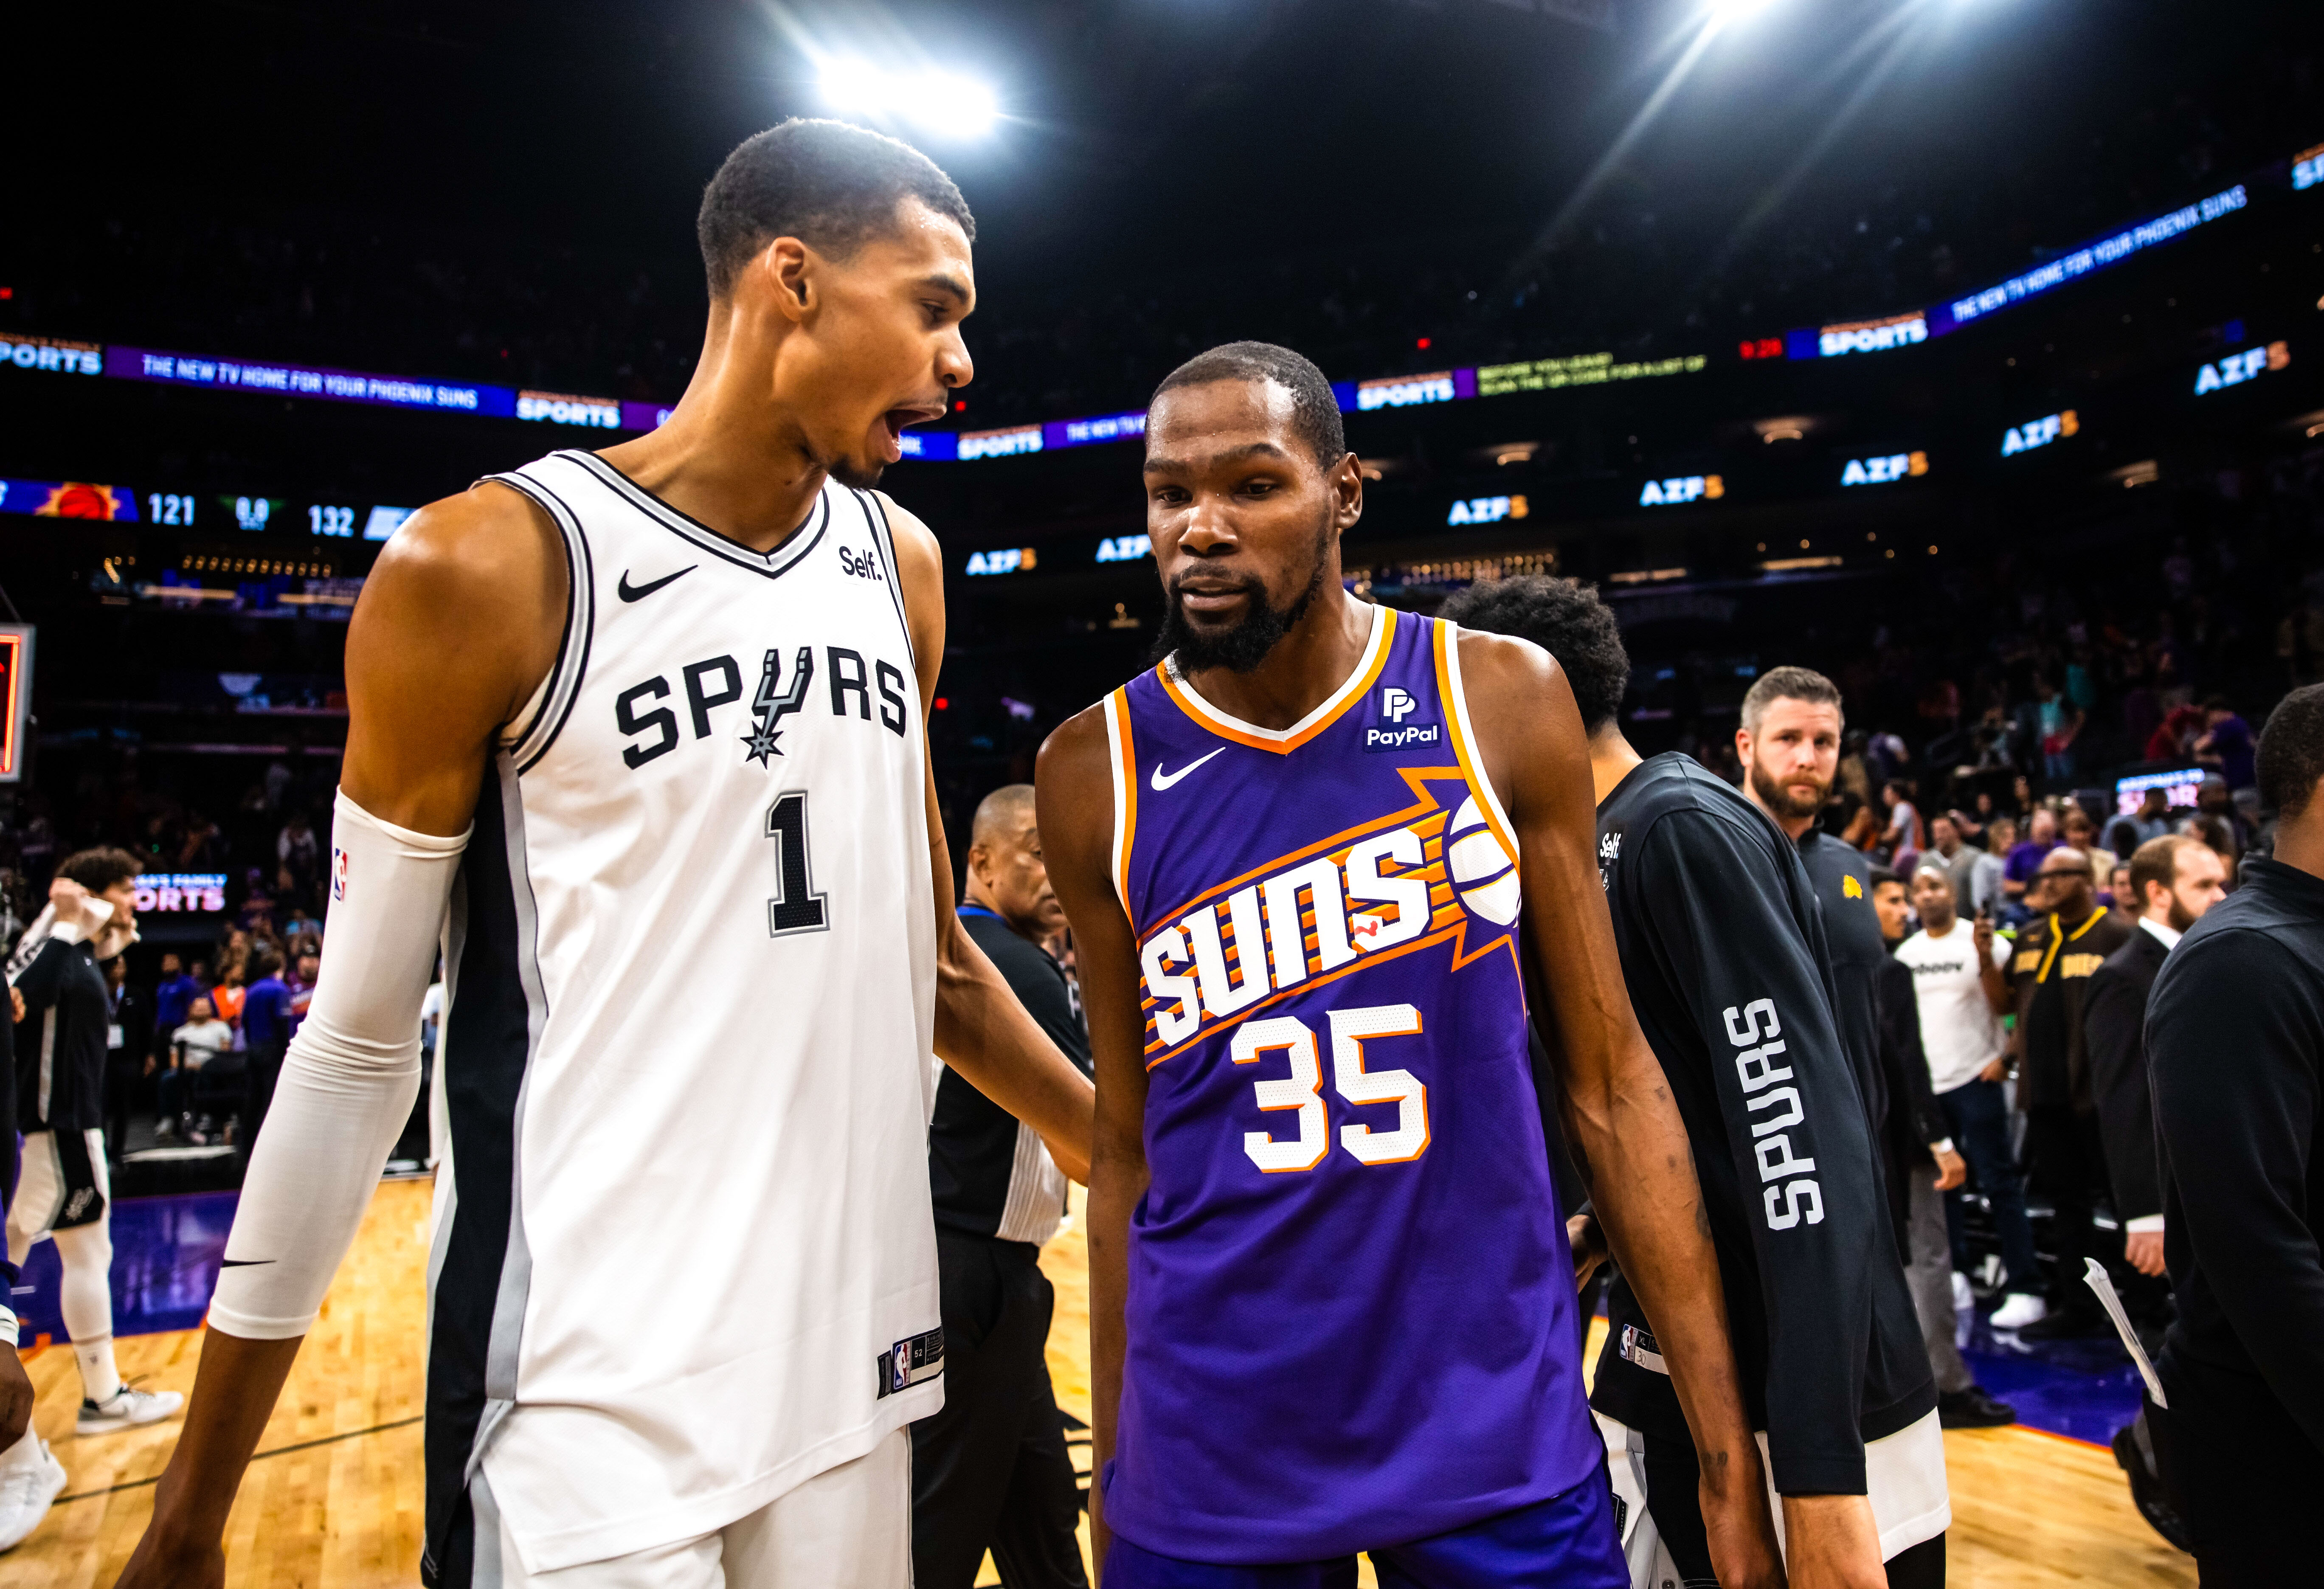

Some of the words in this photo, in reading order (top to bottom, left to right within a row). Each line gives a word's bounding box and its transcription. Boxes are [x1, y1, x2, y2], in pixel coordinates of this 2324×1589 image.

[2023, 259, 2063, 294] HOME
[2062, 248, 2095, 278] FOR
[2093, 232, 2135, 265] YOUR
[2132, 203, 2202, 250] PHOENIX
[2199, 184, 2248, 222] SUNS
[1819, 319, 1929, 357] SPORTS
[0, 341, 102, 375] PORTS
[142, 354, 175, 378] THE
[177, 357, 218, 382] NEW
[218, 362, 242, 385] TV
[241, 365, 289, 390] HOME
[289, 370, 323, 394] FOR
[324, 374, 367, 398] YOUR
[368, 379, 433, 406] PHOENIX
[435, 386, 478, 410] SUNS
[1357, 379, 1455, 411] SPORTS
[516, 397, 621, 429] SPORTS
[957, 430, 1044, 461] SPORTS
[149, 492, 195, 526] 121
[308, 505, 355, 538] 132
[839, 546, 882, 581] Self.
[1095, 534, 1153, 562] AZF
[616, 646, 906, 770] SPURS
[1367, 725, 1438, 746] PayPal
[1600, 832, 1621, 859] Self.
[765, 789, 830, 938] 1
[134, 886, 226, 912] ORTS
[1230, 1004, 1432, 1173] 35
[1723, 998, 1824, 1230] SPURS
[914, 1349, 923, 1358] 52
[1639, 1336, 1646, 1346] XL
[1636, 1350, 1646, 1366] 30
